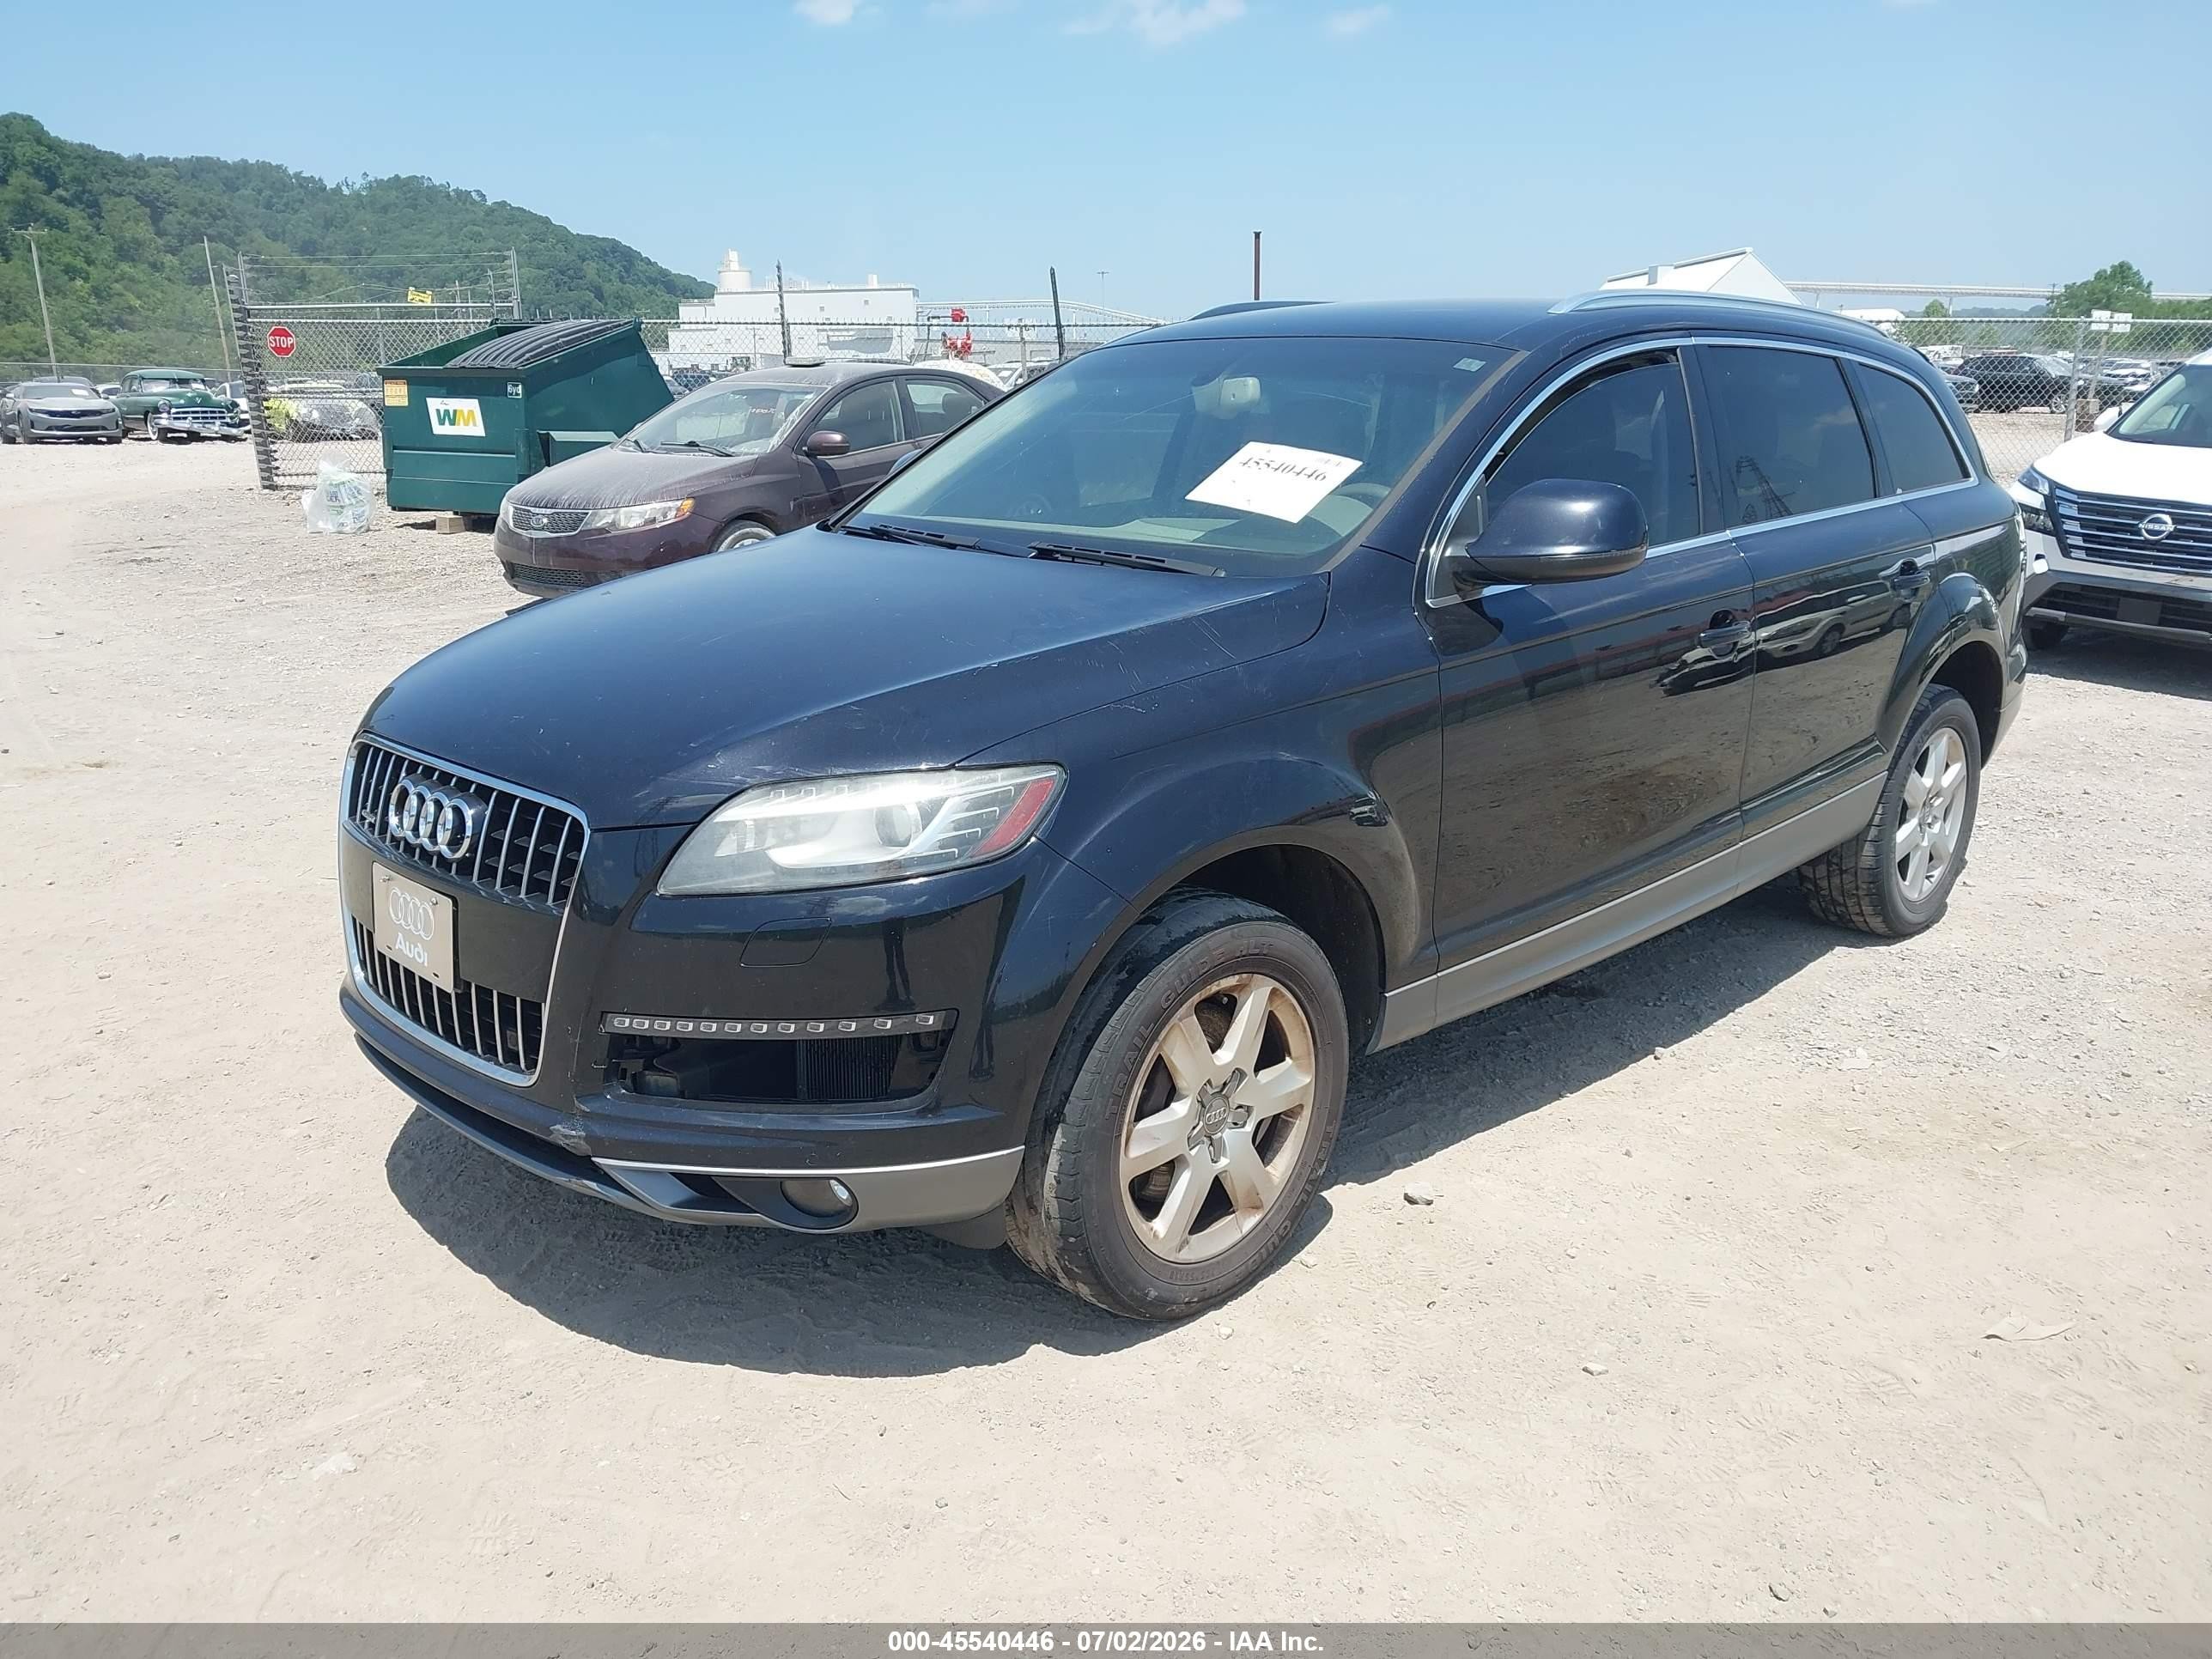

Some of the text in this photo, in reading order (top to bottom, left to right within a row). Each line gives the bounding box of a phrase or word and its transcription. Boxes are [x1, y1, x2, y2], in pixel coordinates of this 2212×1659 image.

[269, 336, 294, 348] STOP
[435, 408, 478, 427] WM
[1239, 457, 1327, 481] 45540446
[2138, 523, 2175, 532] NISSAN
[395, 932, 428, 967] Audi
[1104, 1022, 1155, 1120] TRAIL
[1160, 945, 1226, 1010] GUIDE
